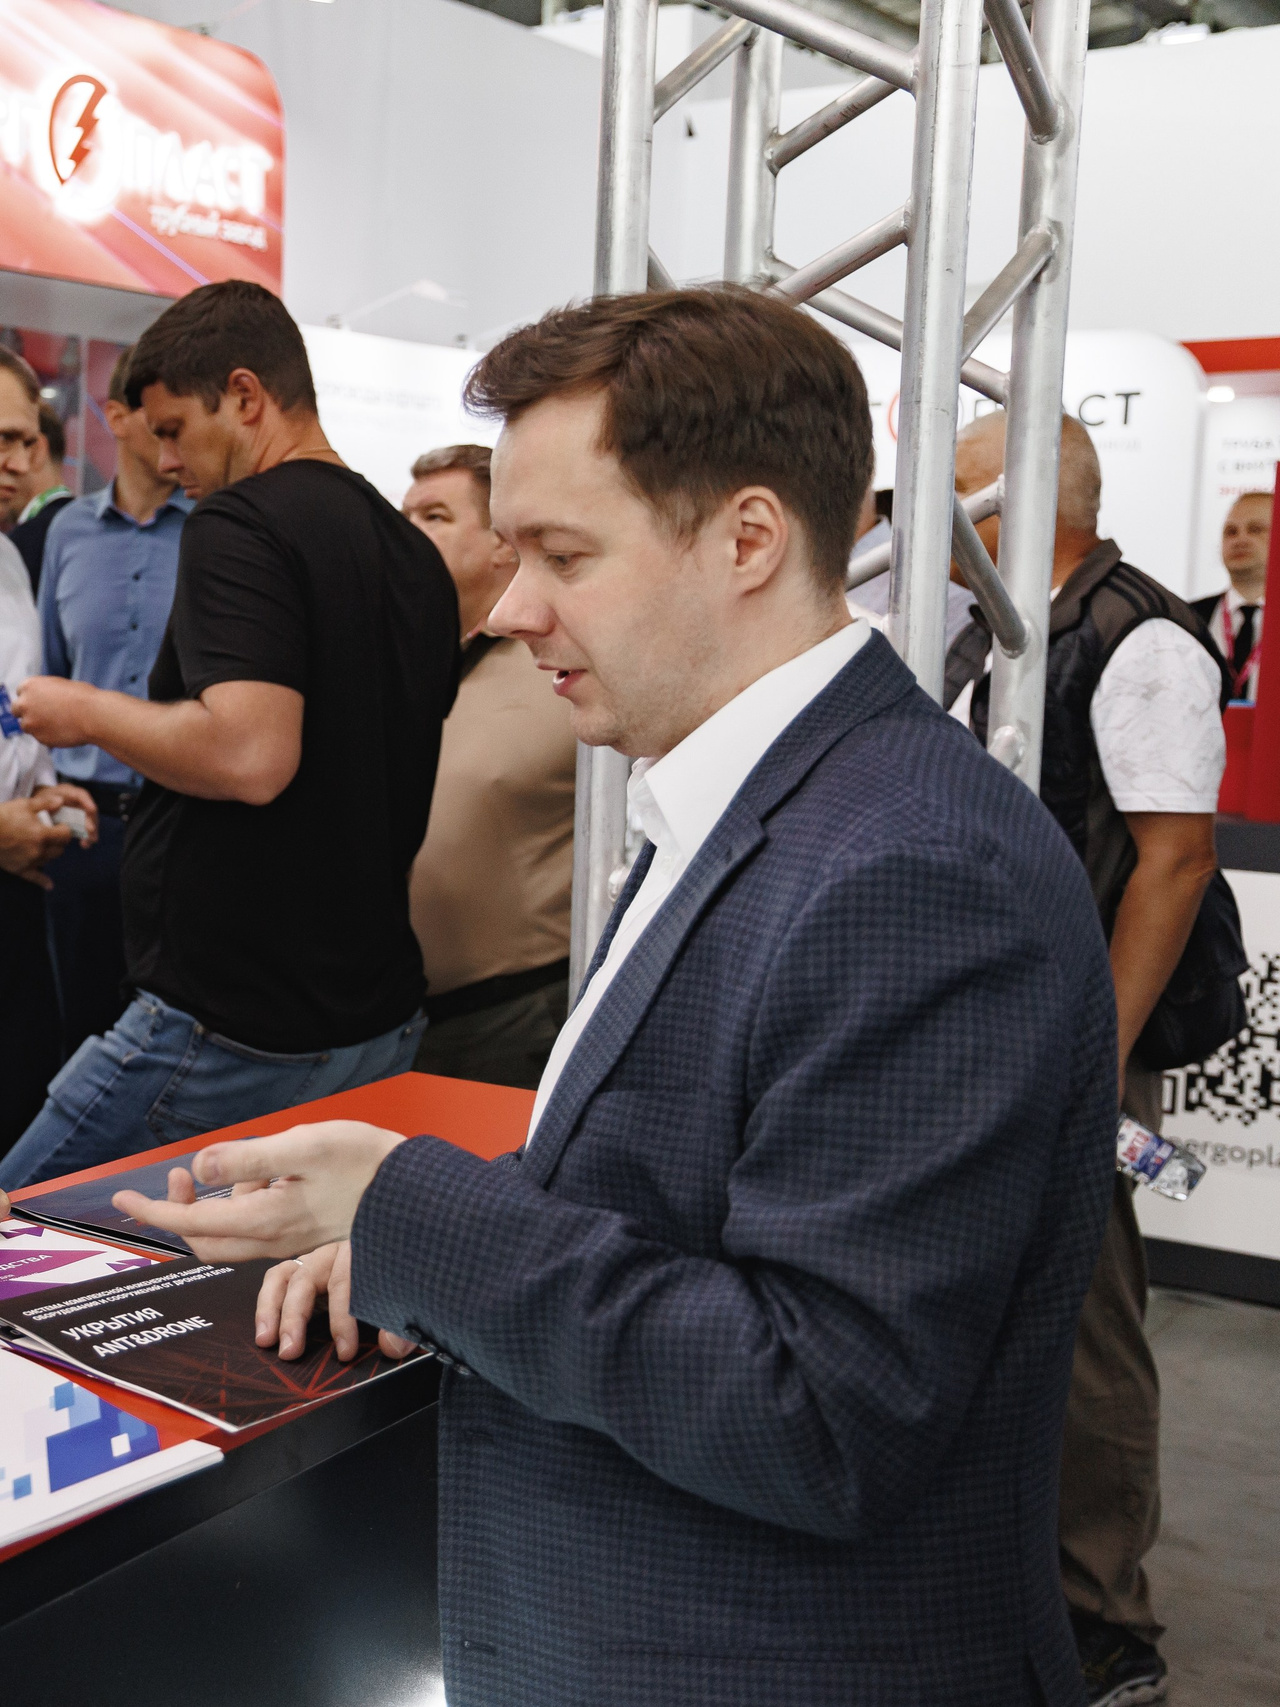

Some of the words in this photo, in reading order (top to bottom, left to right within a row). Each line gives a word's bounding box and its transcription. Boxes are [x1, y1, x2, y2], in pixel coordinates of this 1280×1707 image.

[22, 1303, 64, 1317] СИСТЕМА
[62, 1286, 126, 1305] КОМПЛЕКСНОЙ
[124, 1273, 180, 1291] ИНЖЕНЕРНОЙ
[178, 1264, 214, 1277] ЗАЩИТЫ
[32, 1301, 102, 1320] ОБОРУДОВАНИЯ
[106, 1284, 164, 1302] СООРУЖЕНИЙ
[161, 1281, 174, 1289] ОТ
[172, 1273, 207, 1286] ДРОНОВ
[61, 1307, 164, 1341] УКРЫТИЯ
[92, 1315, 214, 1357] ANT&DRONE
